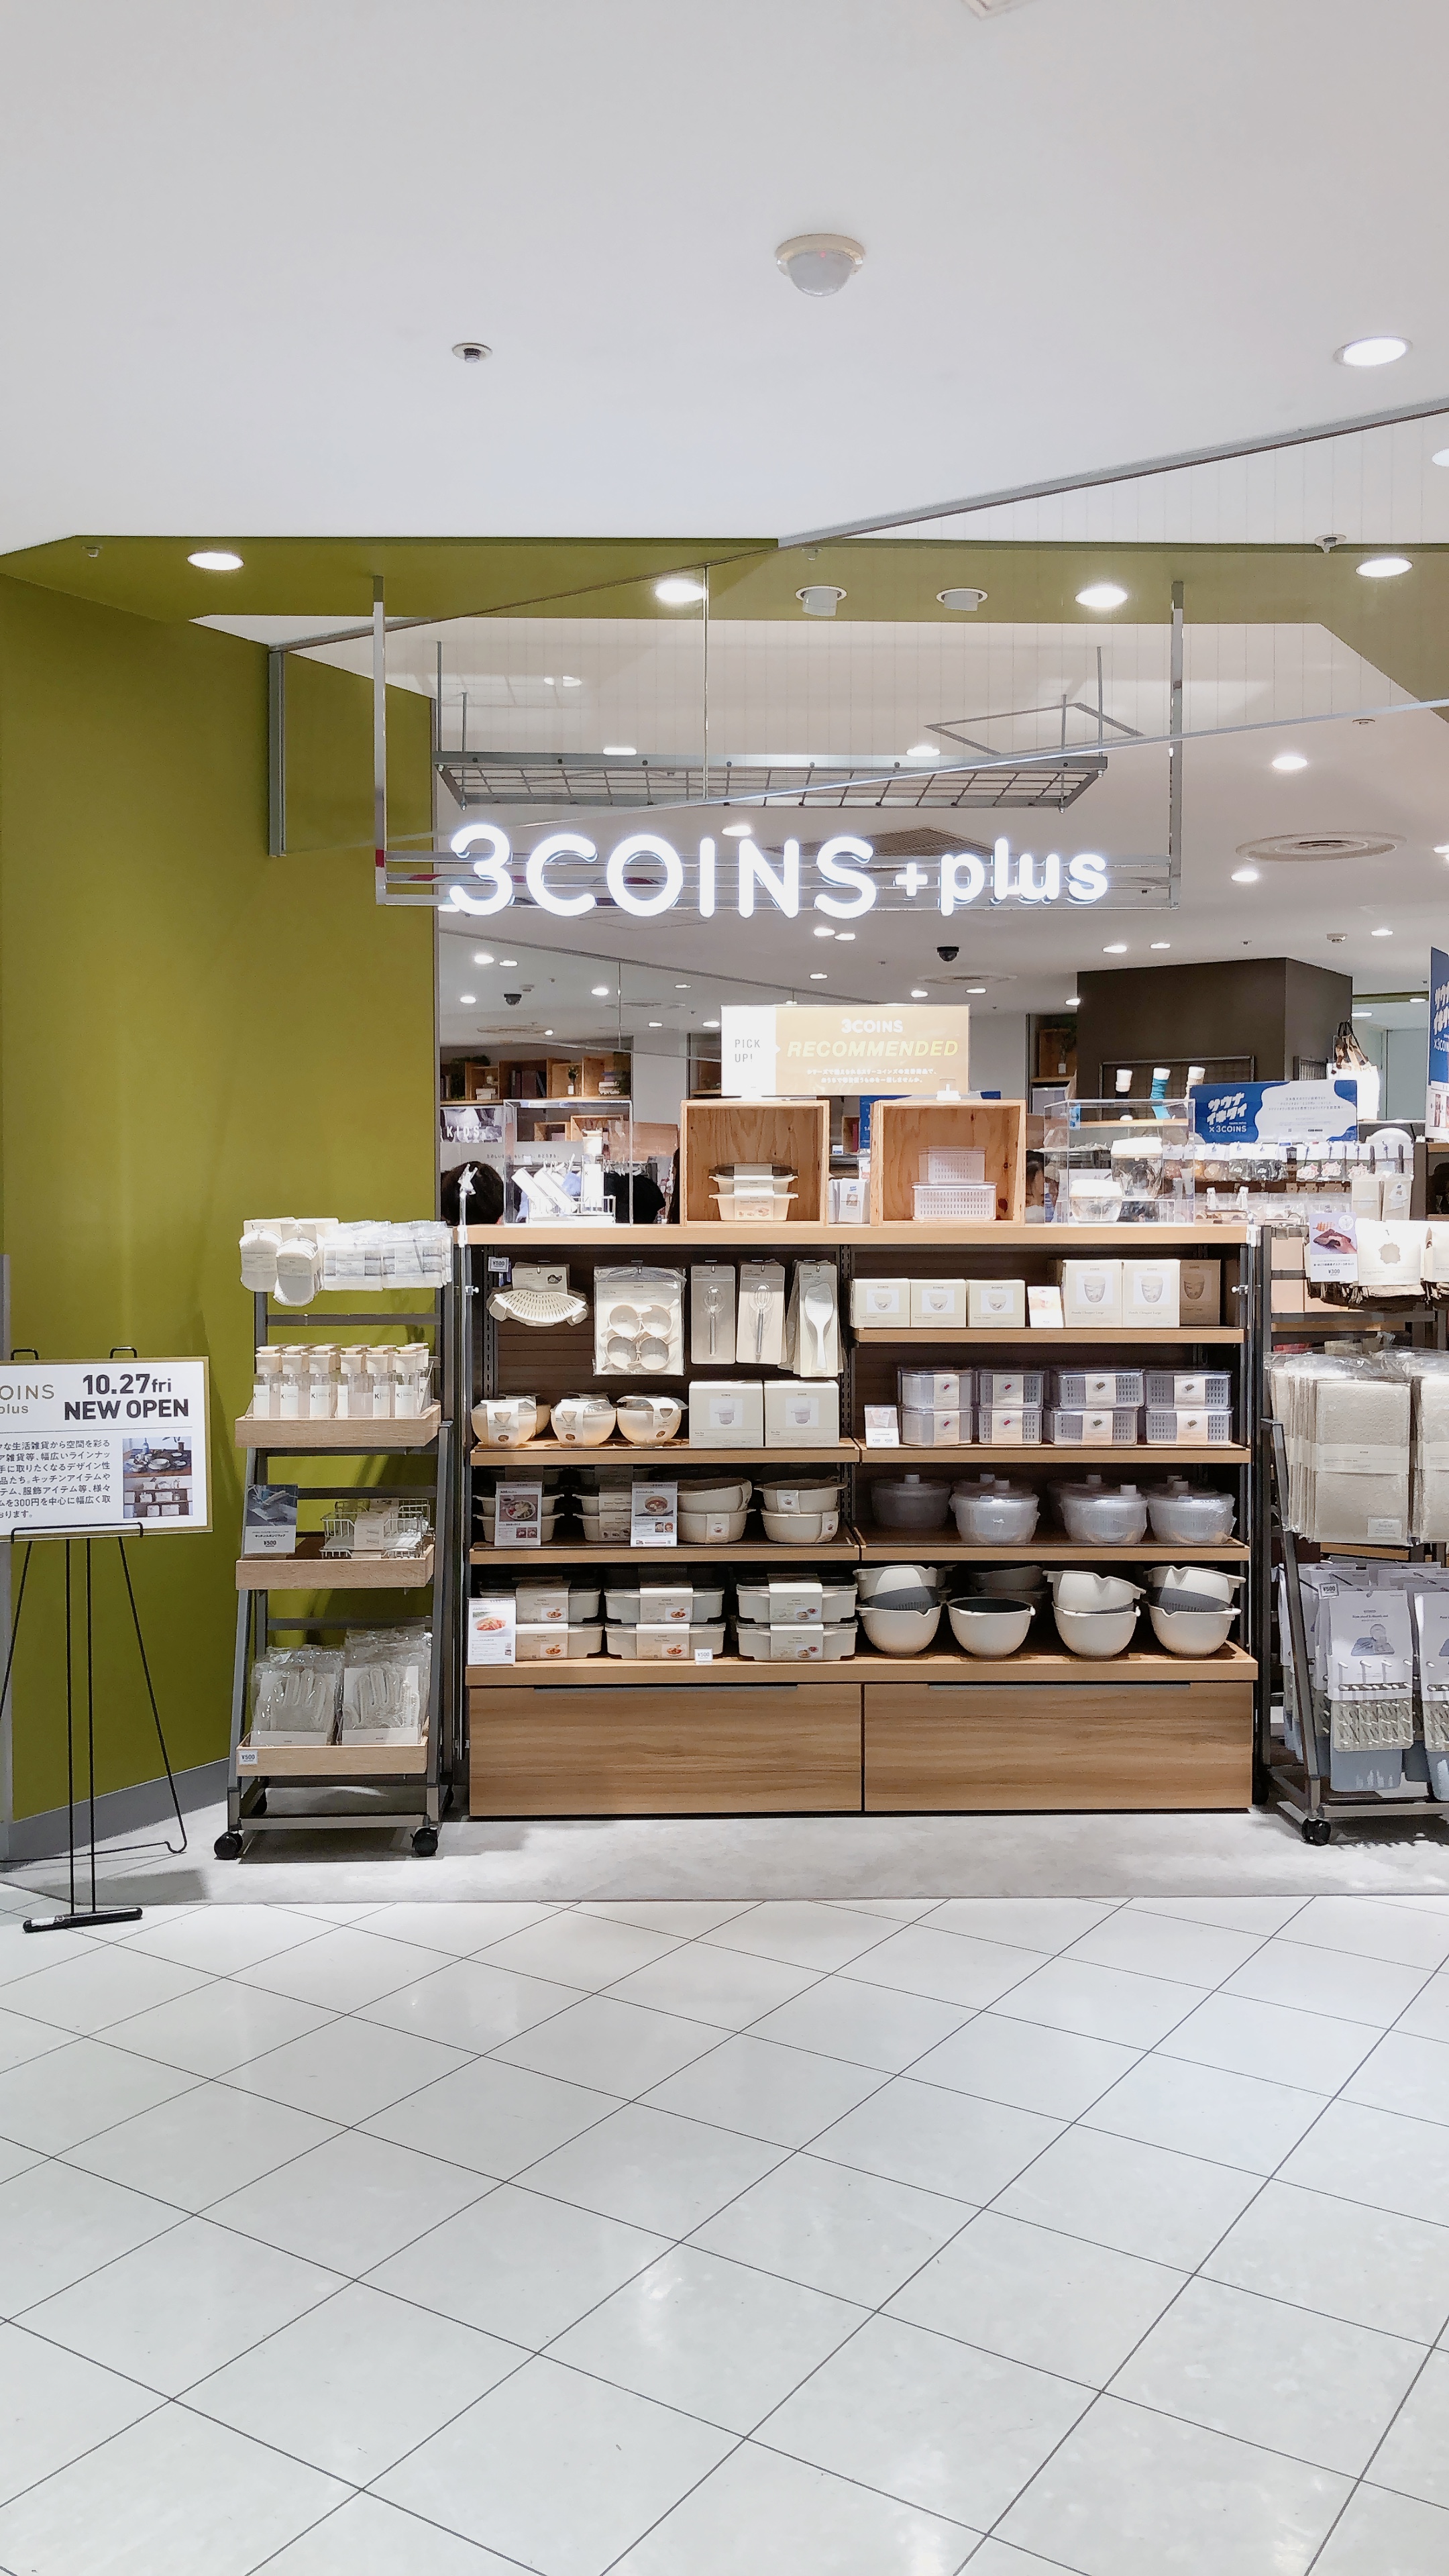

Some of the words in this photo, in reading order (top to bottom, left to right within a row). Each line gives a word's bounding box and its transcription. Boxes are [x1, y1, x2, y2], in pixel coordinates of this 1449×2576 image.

[449, 824, 877, 919] 3COINS
[841, 1018, 904, 1034] 3COINS
[735, 1038, 761, 1049] PICK
[787, 1040, 959, 1058] RECOMMENDED
[735, 1053, 753, 1063] UP!
[1208, 1091, 1245, 1112] サウナ
[1206, 1102, 1248, 1126] イキタイ
[445, 1126, 480, 1138] KIDS
[1216, 1125, 1247, 1133] 3COINS
[64, 1399, 121, 1421] NEW
[126, 1399, 189, 1419] OPEN
[0, 1440, 110, 1450] な生活雑貨から空間を彩る
